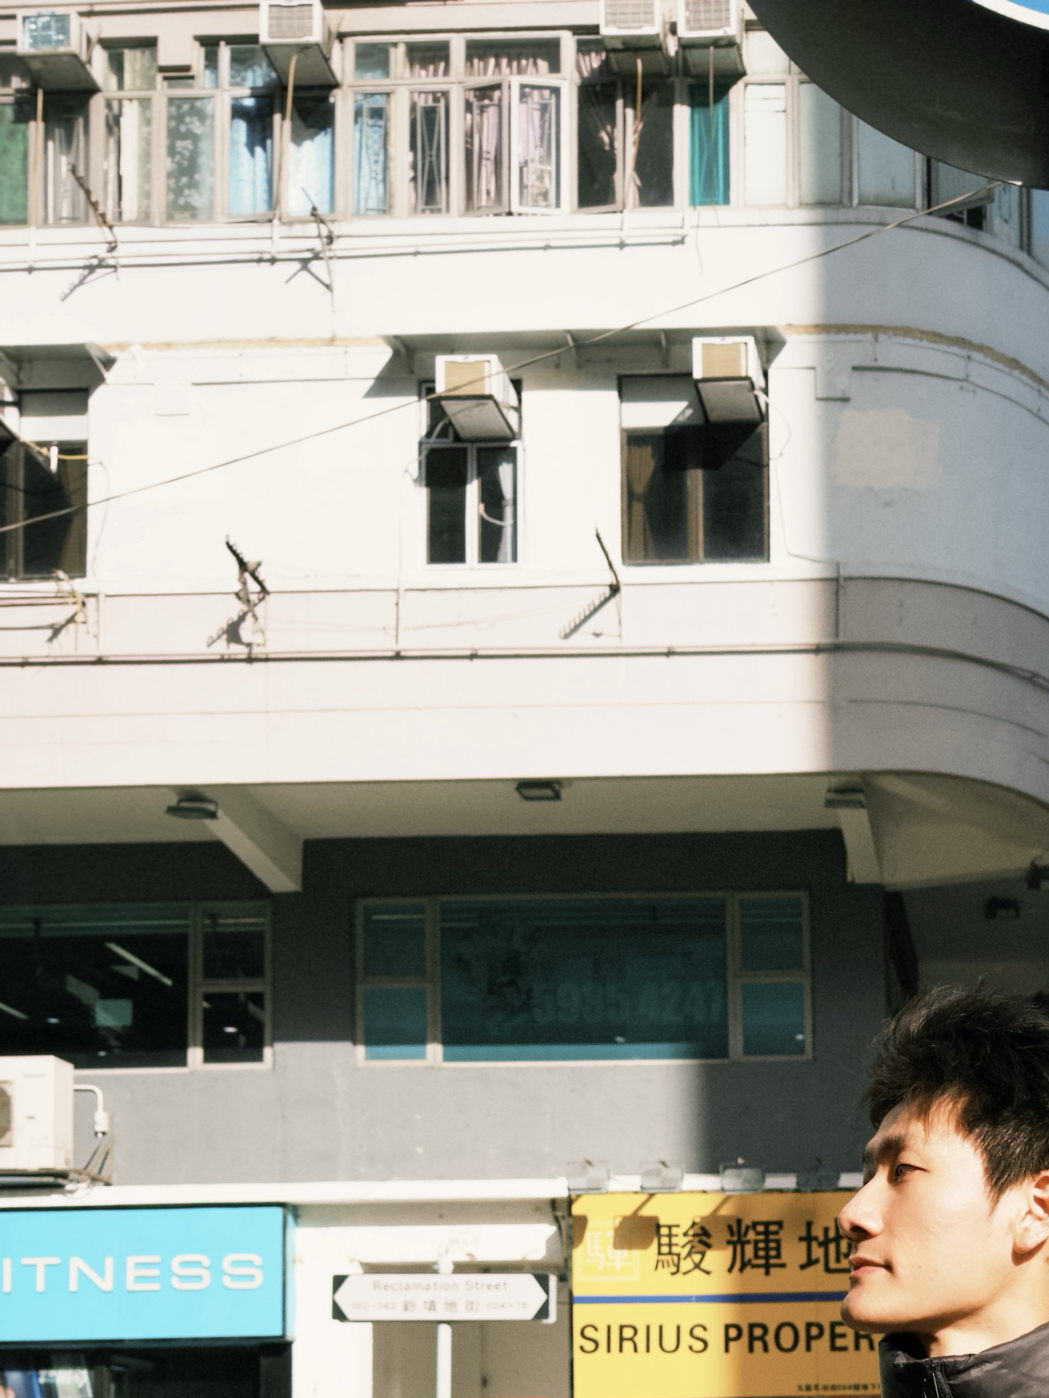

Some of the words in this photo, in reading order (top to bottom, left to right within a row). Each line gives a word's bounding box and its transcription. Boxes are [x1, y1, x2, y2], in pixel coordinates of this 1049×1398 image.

[654, 1217, 852, 1276] 駿輝地
[372, 1279, 459, 1292] Reclamation
[465, 1279, 508, 1292] Street
[579, 1323, 709, 1354] SIRIUS
